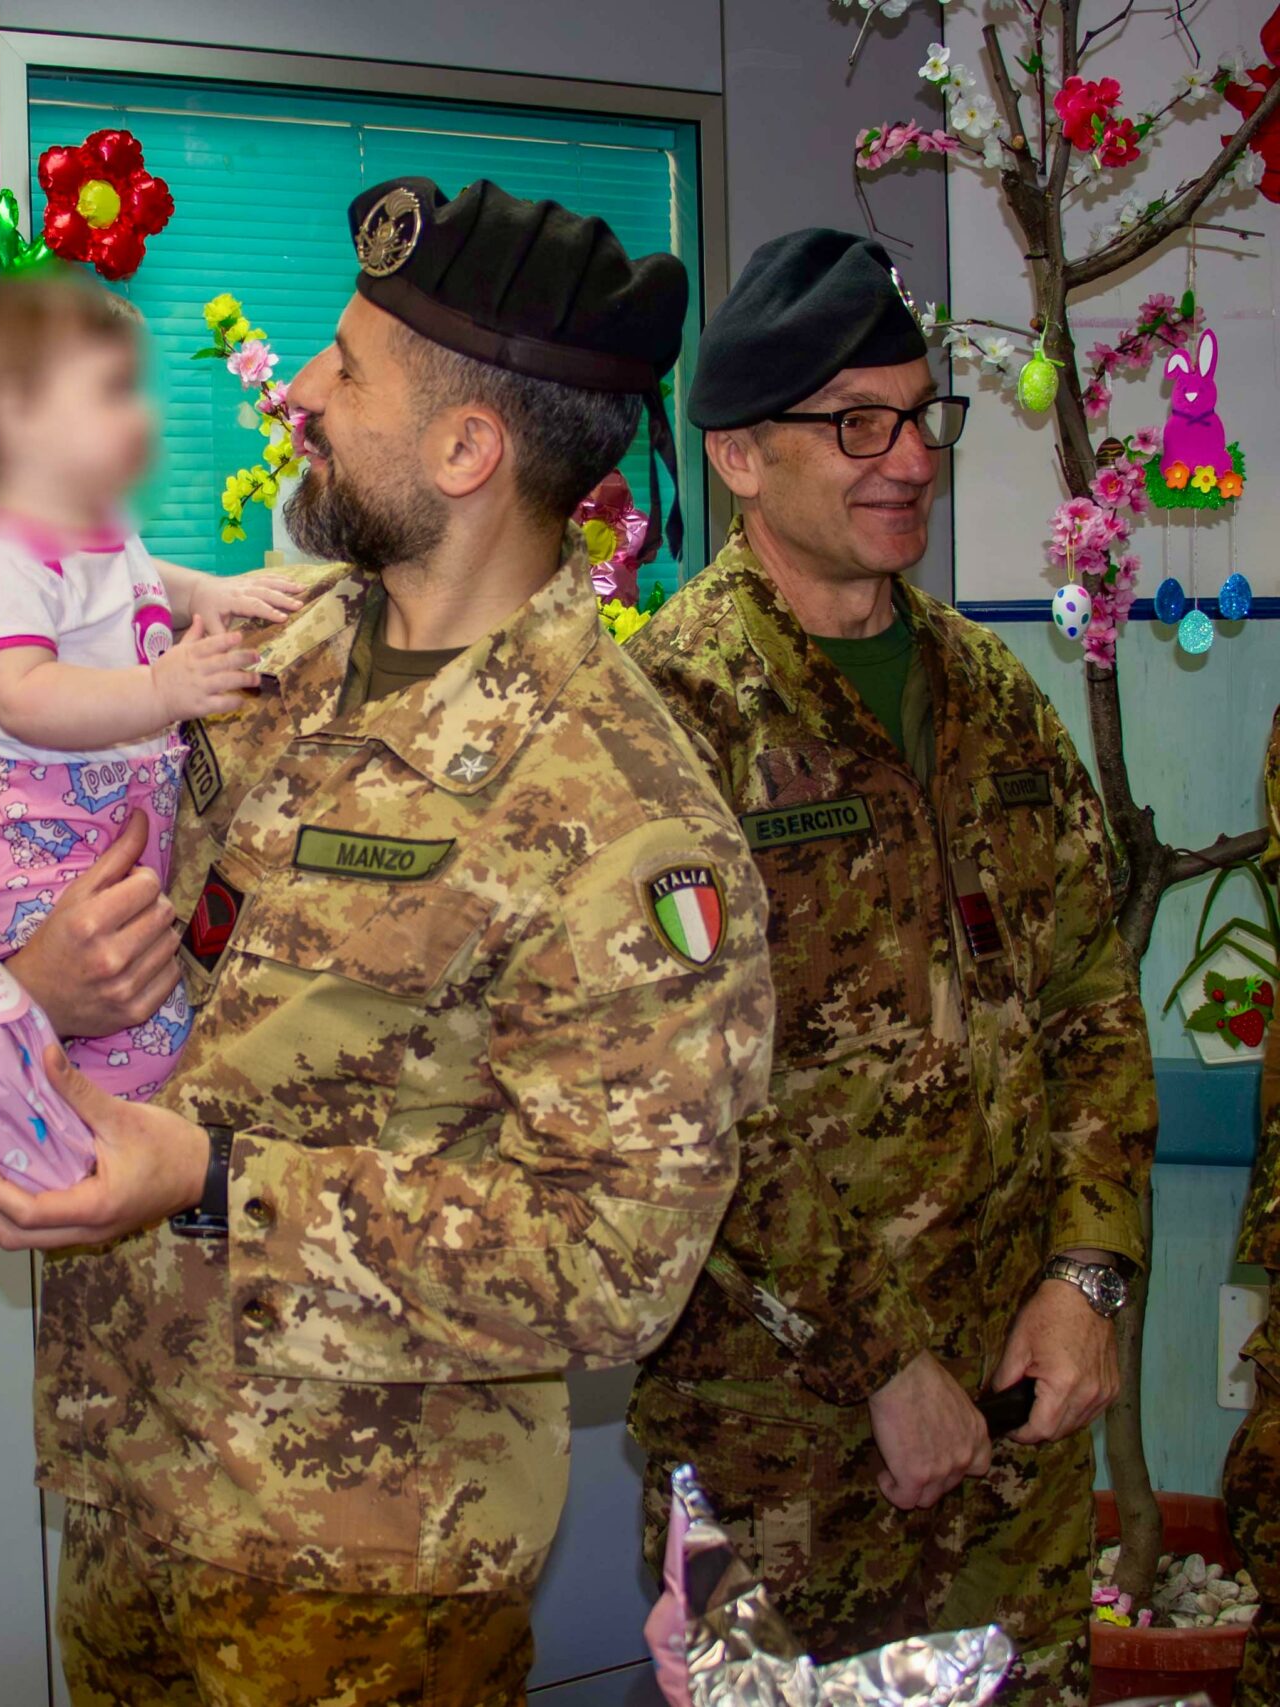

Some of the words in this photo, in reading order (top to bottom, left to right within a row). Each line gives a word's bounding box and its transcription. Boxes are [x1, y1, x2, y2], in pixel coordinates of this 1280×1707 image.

[84, 762, 127, 794] POP
[756, 806, 858, 841] ESERCITO
[336, 842, 416, 871] MANZO
[653, 870, 708, 897] ITALIA
